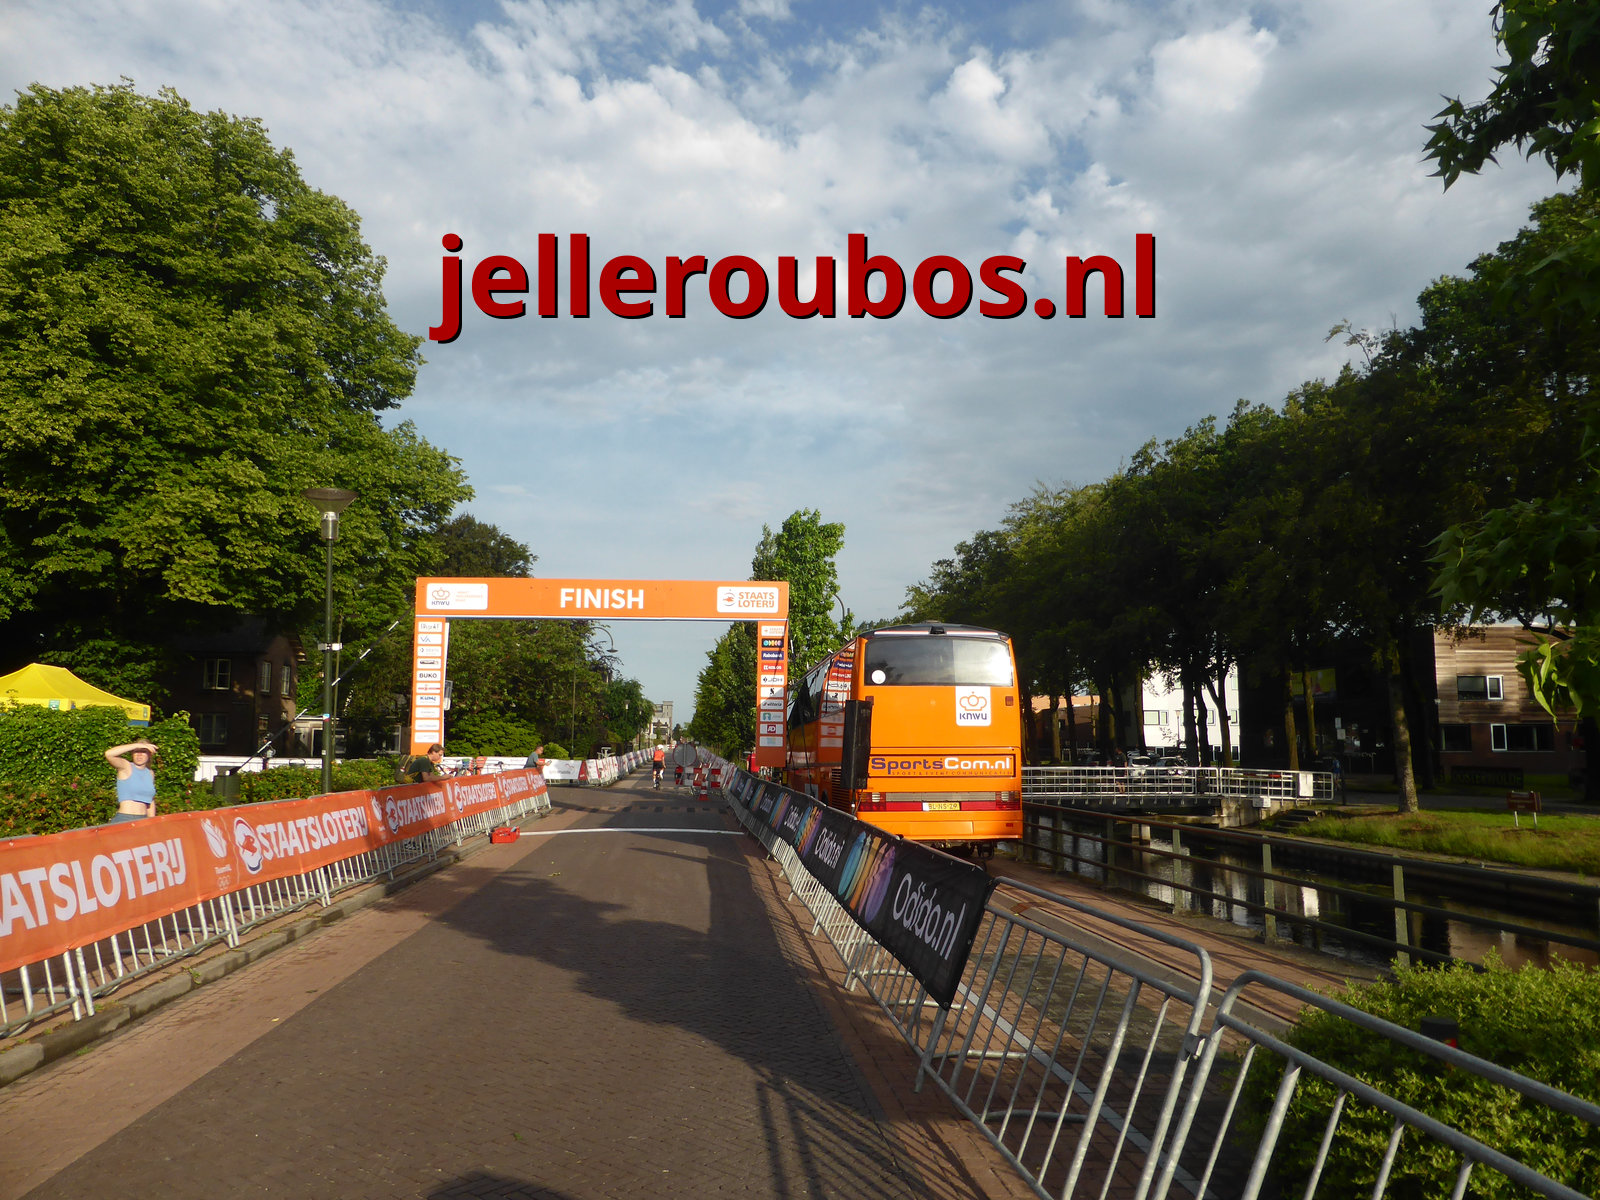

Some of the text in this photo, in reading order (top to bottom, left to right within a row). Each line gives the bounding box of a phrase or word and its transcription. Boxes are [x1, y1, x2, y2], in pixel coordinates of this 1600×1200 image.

[560, 588, 644, 609] FINISH
[738, 591, 775, 600] STAATS
[738, 600, 775, 608] LOTERIJ
[871, 757, 1010, 775] SportsCom.nl
[256, 806, 368, 861] STAATSLOTERIJ
[0, 838, 187, 937] ATSLOTERIJ
[892, 872, 967, 961] Odido.nl
